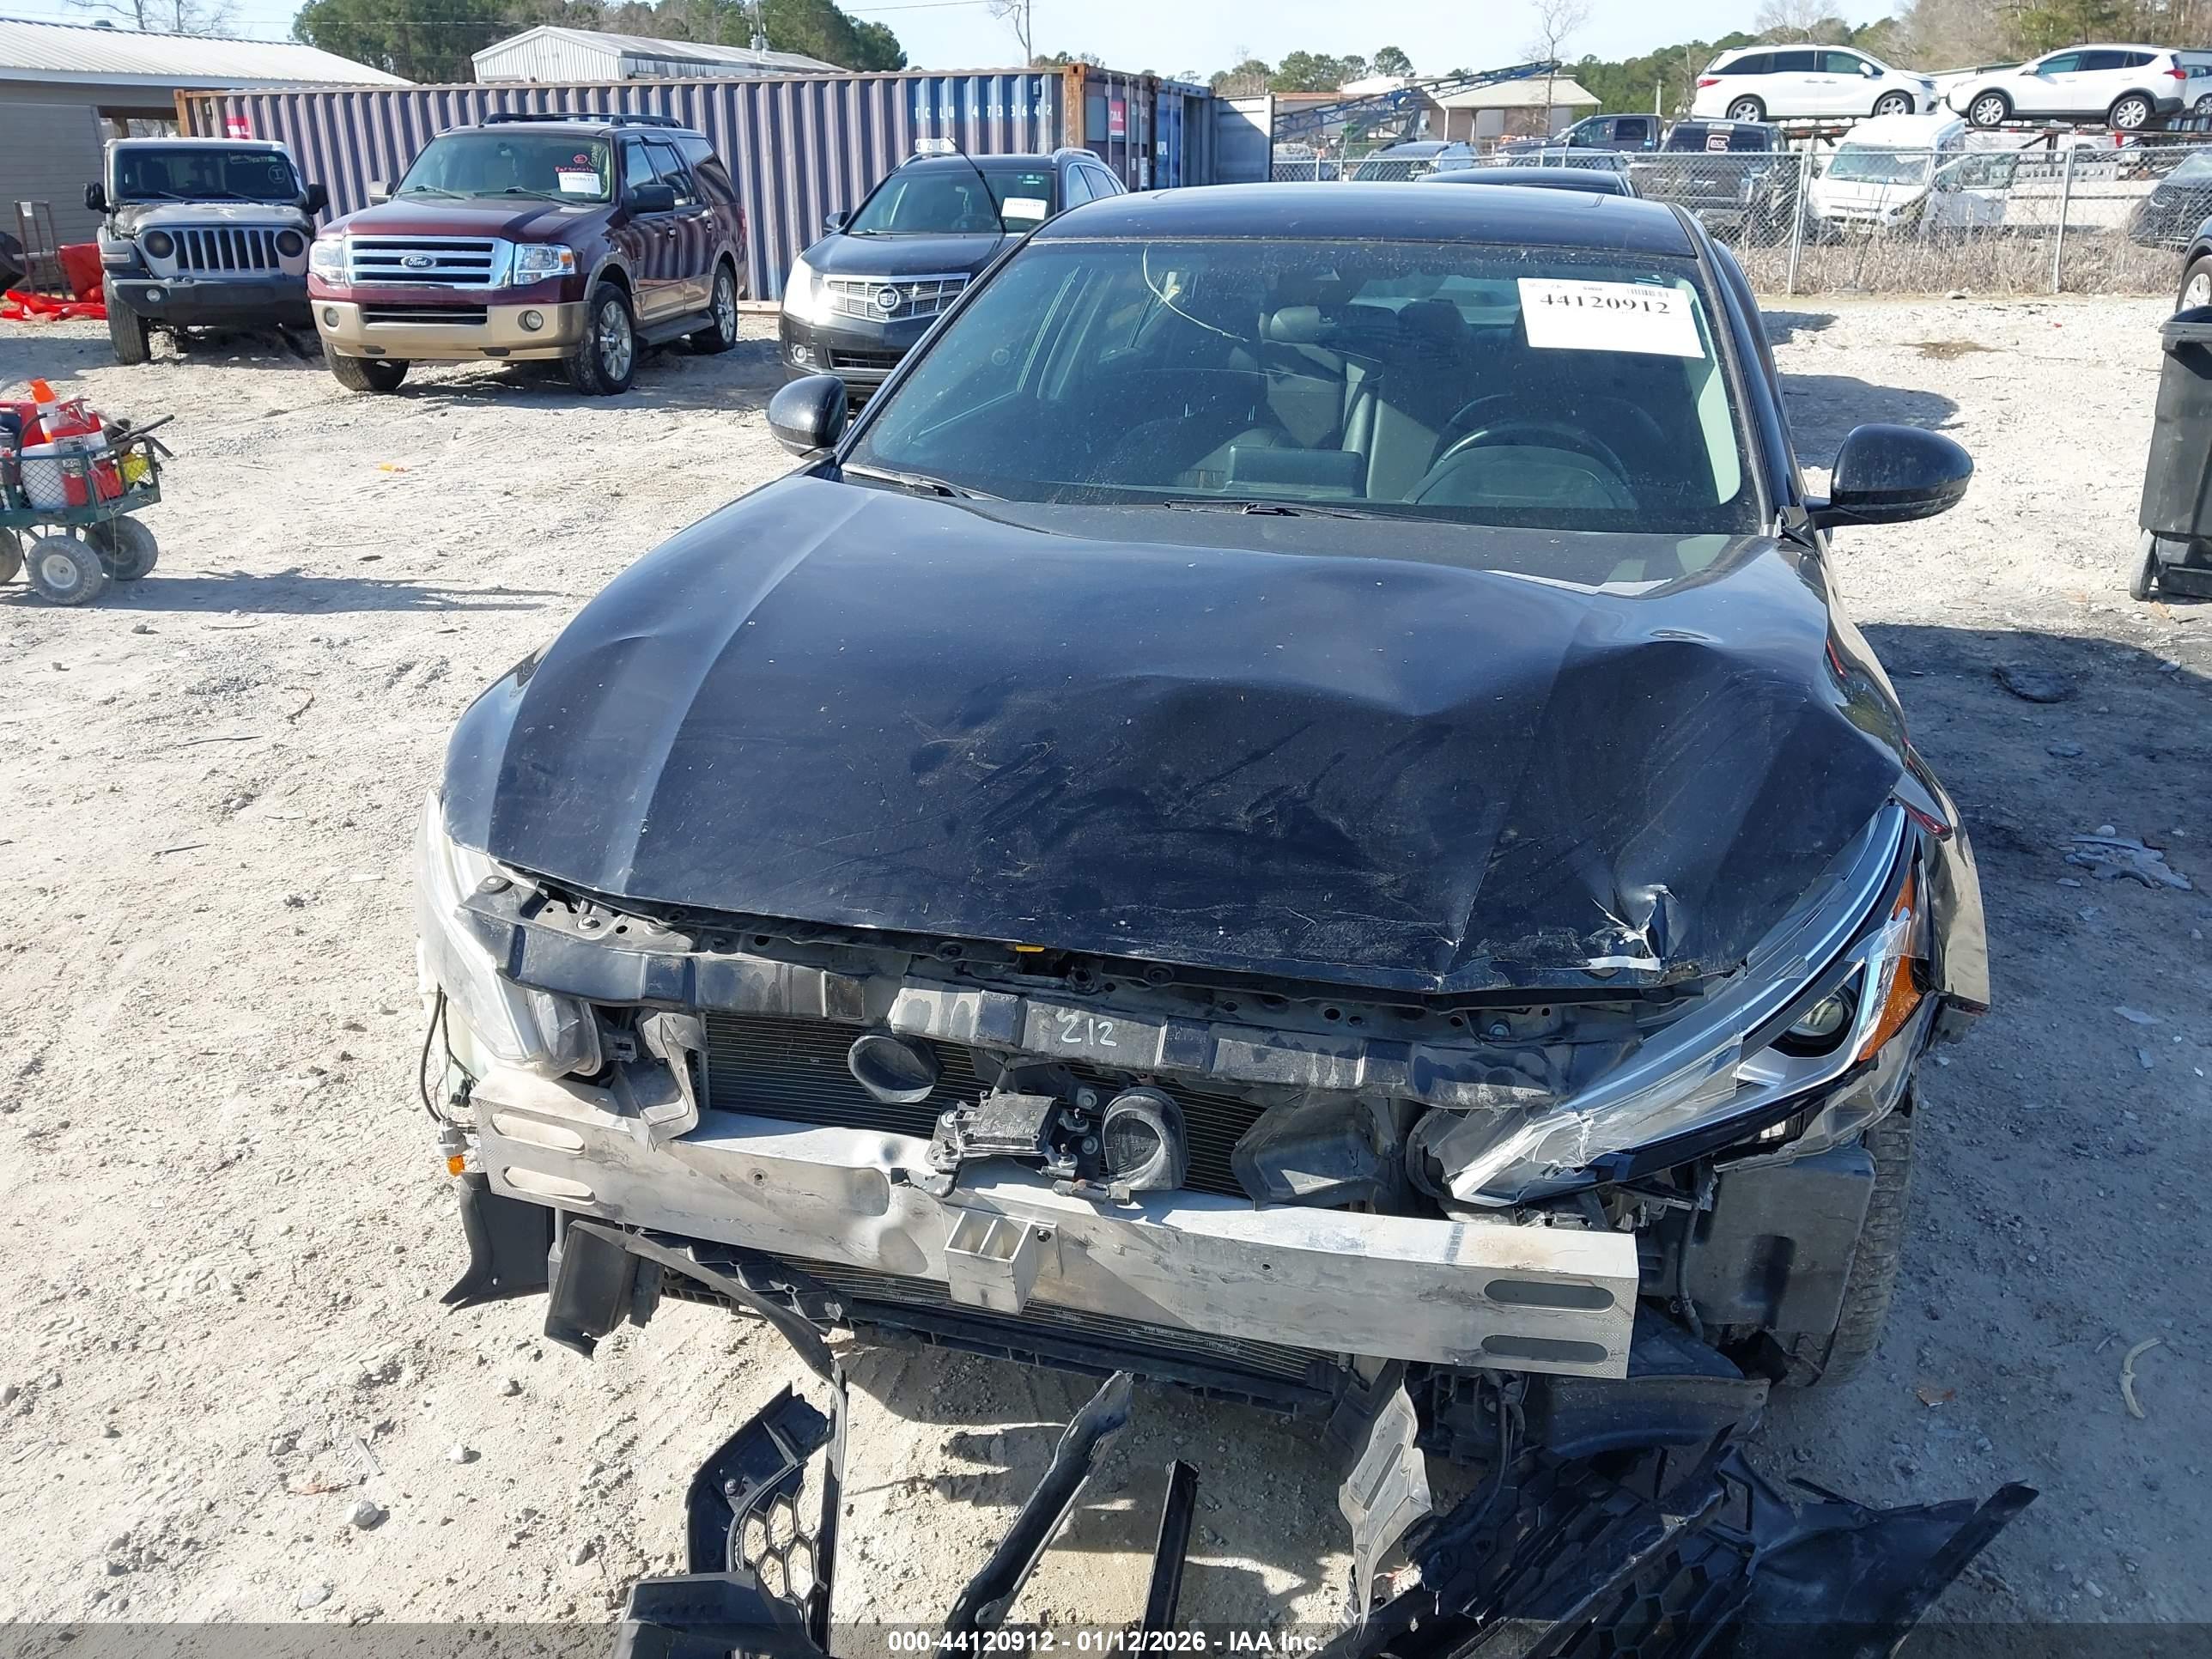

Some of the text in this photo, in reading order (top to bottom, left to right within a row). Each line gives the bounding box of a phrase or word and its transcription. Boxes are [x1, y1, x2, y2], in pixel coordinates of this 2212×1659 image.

[915, 105, 955, 119] TCLU
[408, 258, 428, 266] Ford
[1540, 294, 1670, 314] 44120912
[1056, 1012, 1117, 1047] 212
